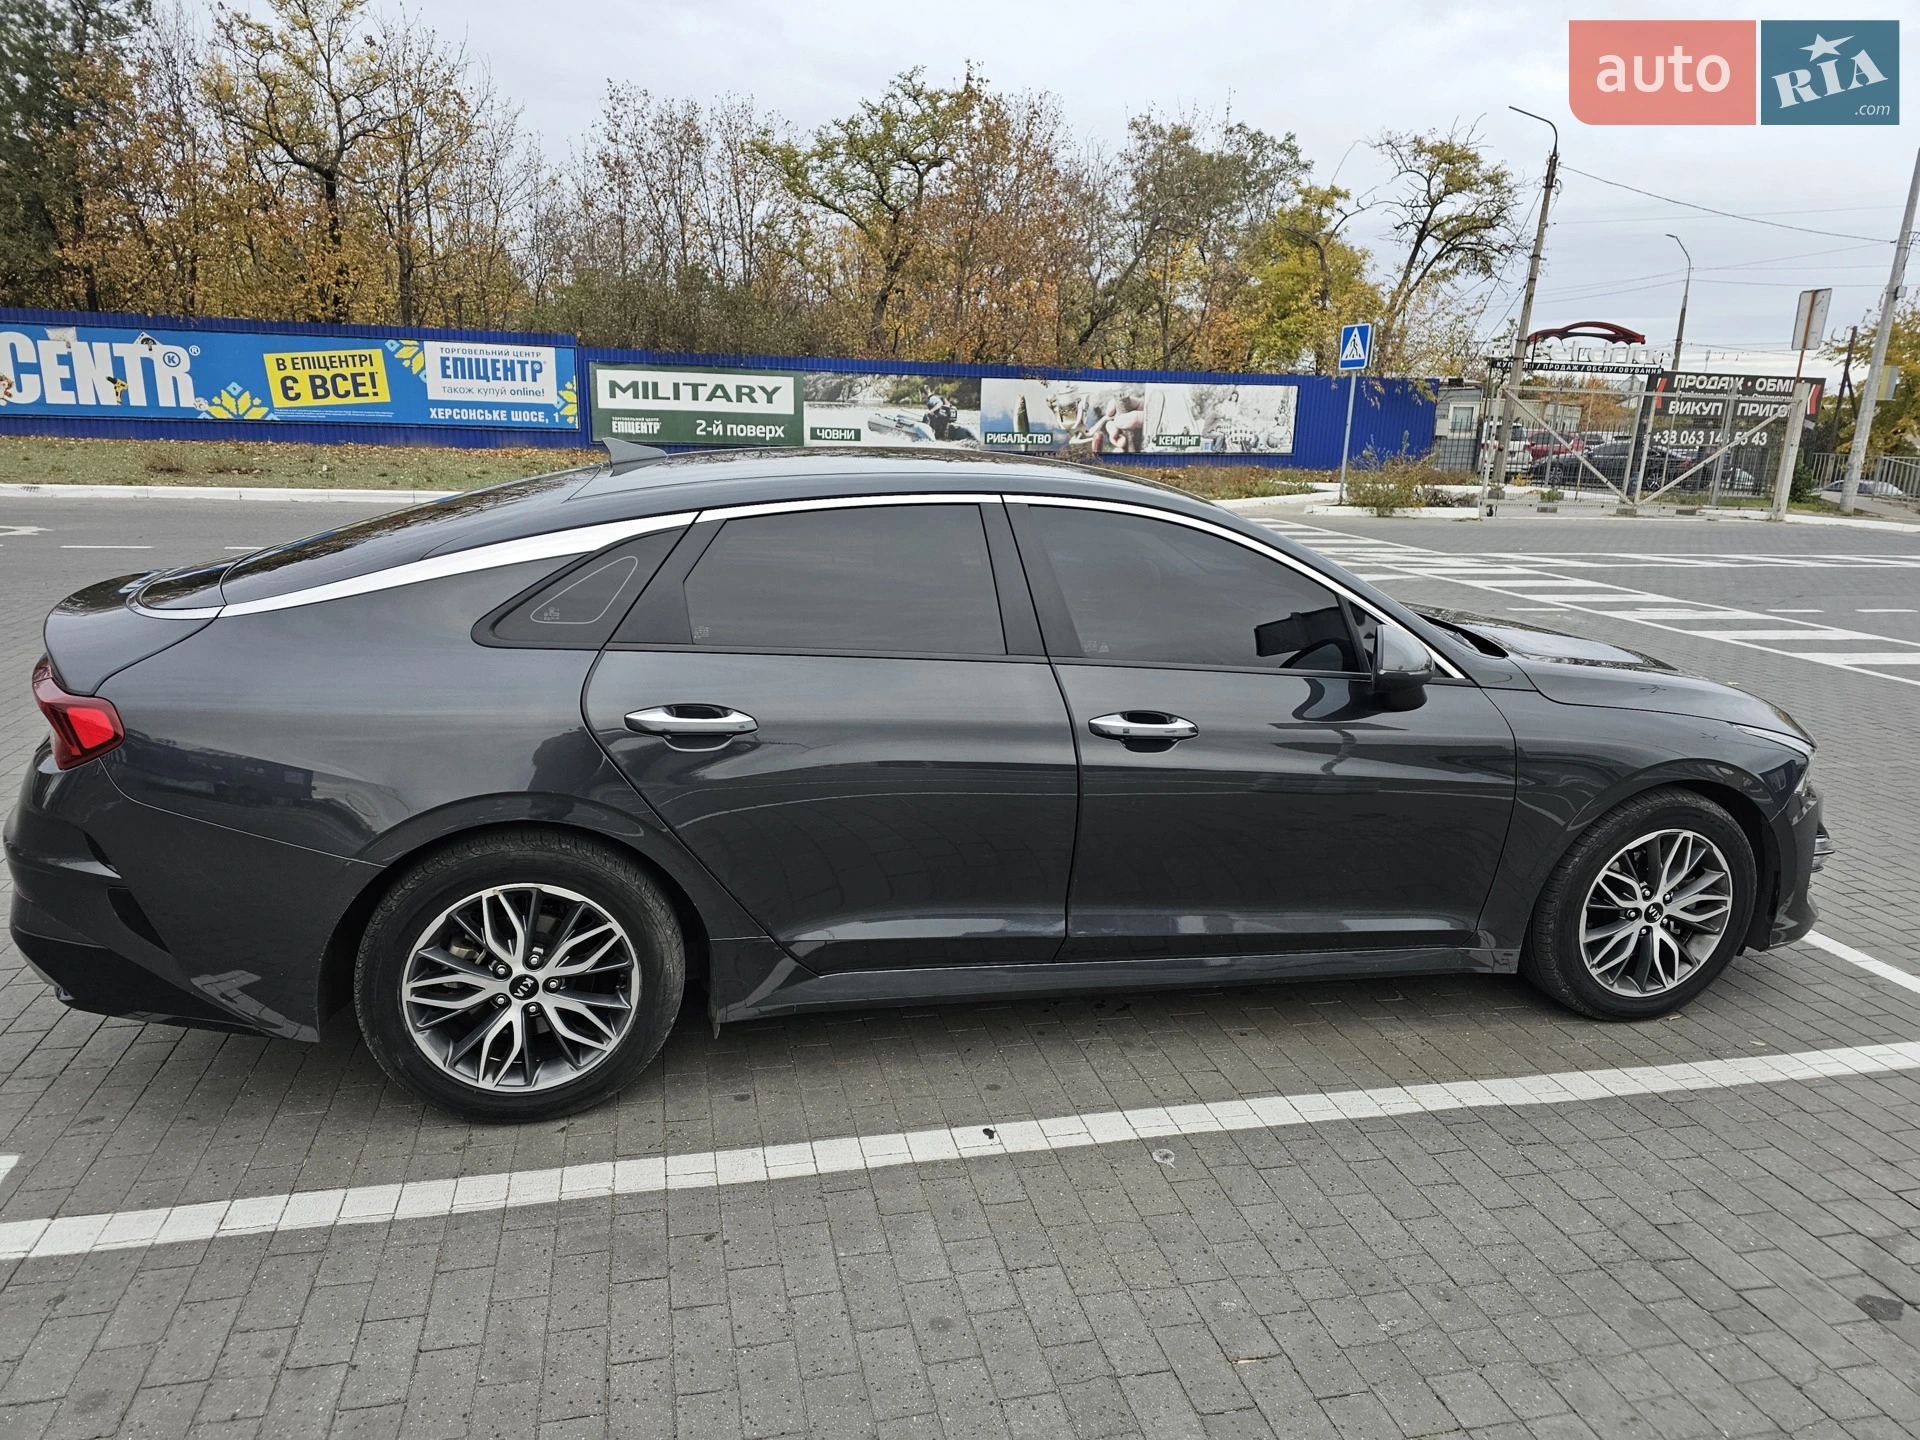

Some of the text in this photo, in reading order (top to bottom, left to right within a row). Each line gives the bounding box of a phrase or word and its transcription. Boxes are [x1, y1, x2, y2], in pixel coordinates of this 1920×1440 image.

[440, 347, 510, 357] ТОРГОВЕЛЬНИЙ
[275, 354, 374, 371] В ЕПІЦЕНТРІ
[440, 356, 543, 382] ЕПІЦЕНТР
[1542, 363, 1579, 371] ПРОДАЖ
[1586, 365, 1663, 374] ОБСЛУГОВУВАННЯ
[280, 372, 379, 401] Є ВСЕ!
[441, 386, 545, 397] також купуй online!
[1673, 374, 1794, 393] ПРОДАЖ ОБМІ
[608, 380, 782, 404] MILITARY
[429, 407, 559, 424] ХЕРСОНСЬКЕ ШОСЕ, 1
[1668, 401, 1791, 418] ВИКУП ПРИГО
[612, 420, 661, 434] ЕПІЦЕНТР
[695, 420, 785, 440] 2-й поверх
[816, 429, 855, 440] ЧОВНИ
[986, 433, 1052, 444] РИБАЛЬСТВО
[1159, 436, 1200, 446] КЕМПІНГ
[1653, 430, 1677, 445] +38
[1680, 430, 1705, 445] 063
[1751, 431, 1768, 446] 43
